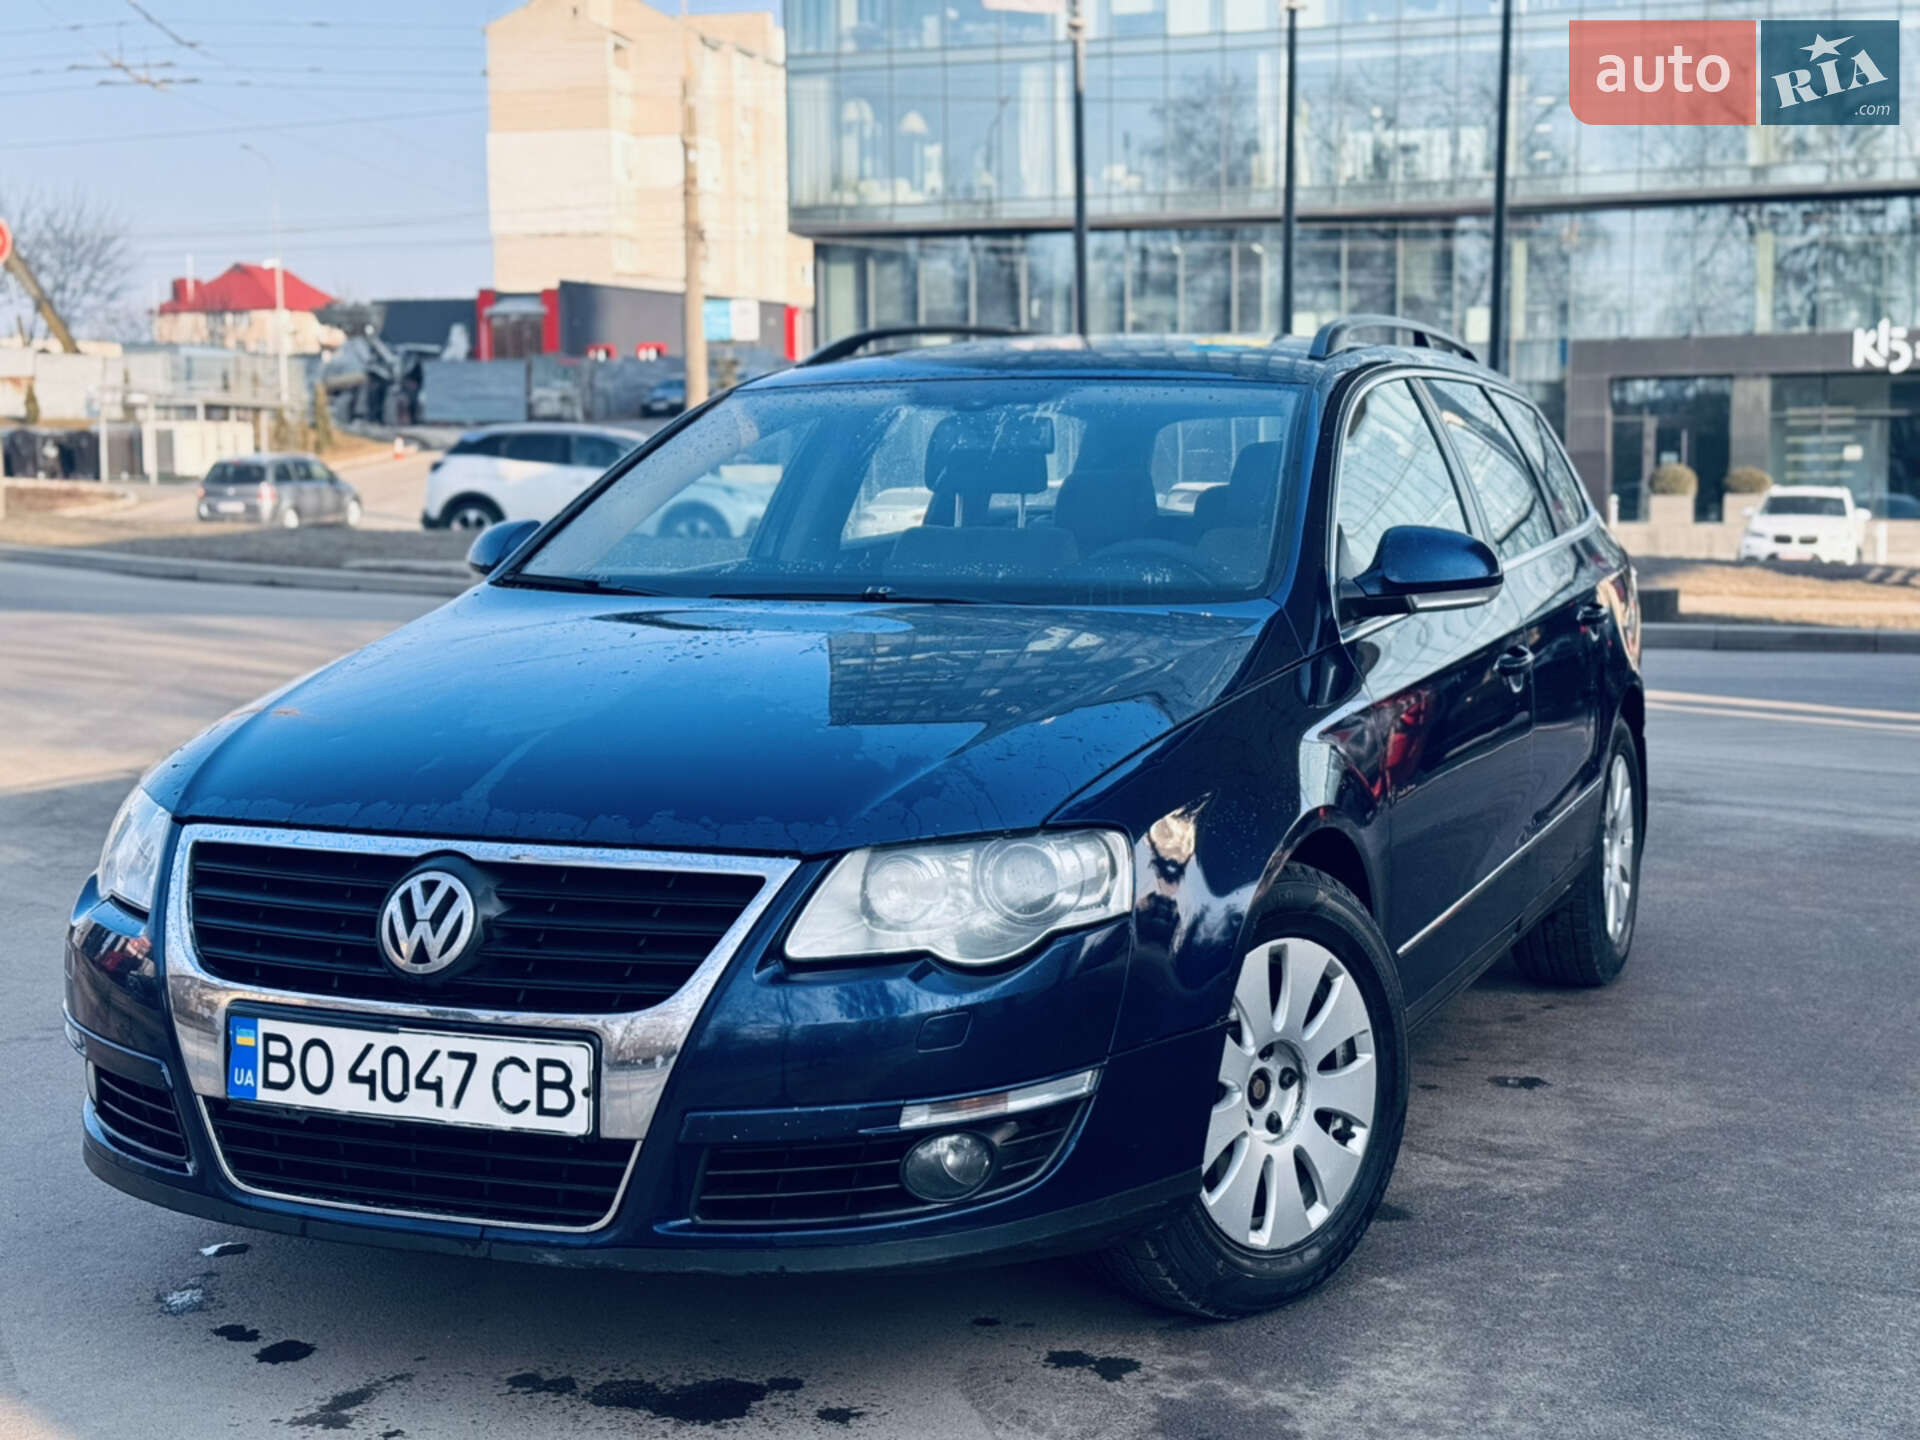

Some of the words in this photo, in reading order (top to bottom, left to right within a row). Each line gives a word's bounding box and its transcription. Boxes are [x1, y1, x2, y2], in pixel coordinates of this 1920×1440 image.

[234, 1067, 255, 1087] UA
[261, 1032, 334, 1095] BO
[348, 1043, 477, 1109] 4047
[492, 1056, 576, 1118] CB
